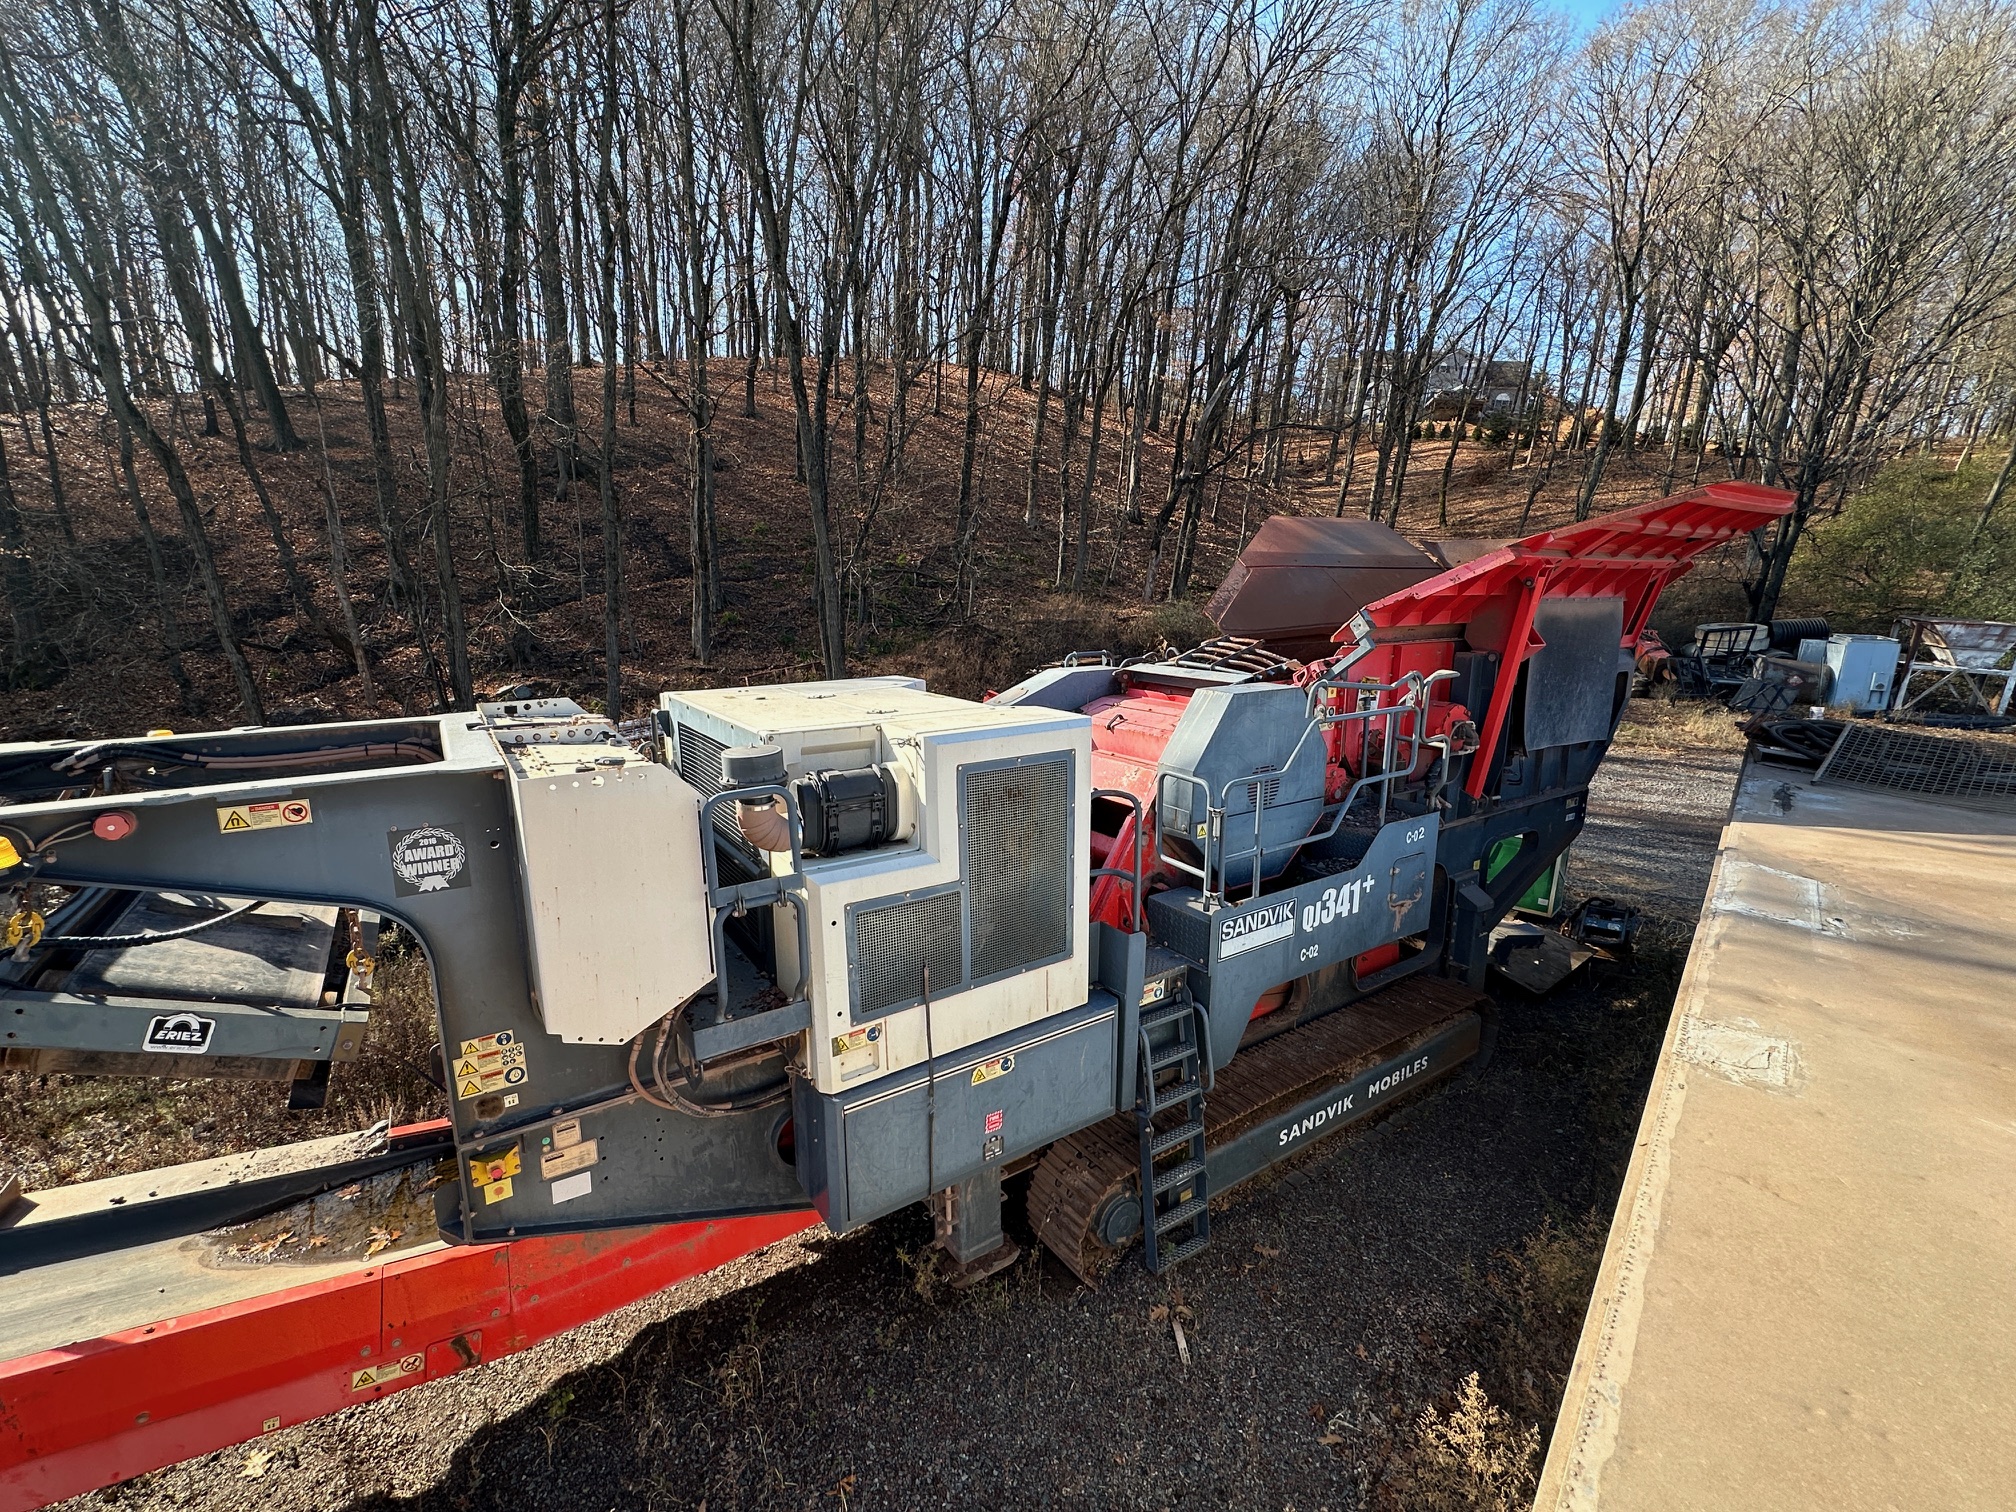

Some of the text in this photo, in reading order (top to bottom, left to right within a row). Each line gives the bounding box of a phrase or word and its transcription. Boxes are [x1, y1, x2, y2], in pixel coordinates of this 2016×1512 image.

[1406, 826, 1425, 844] C-02
[404, 844, 454, 862] AWARD
[401, 857, 460, 877] WINNER
[1221, 901, 1294, 940] SANDVIK
[1300, 944, 1319, 962] C-02
[154, 1030, 202, 1042] ERIEZ
[1279, 1056, 1428, 1146] SANDVIK MOBILES
